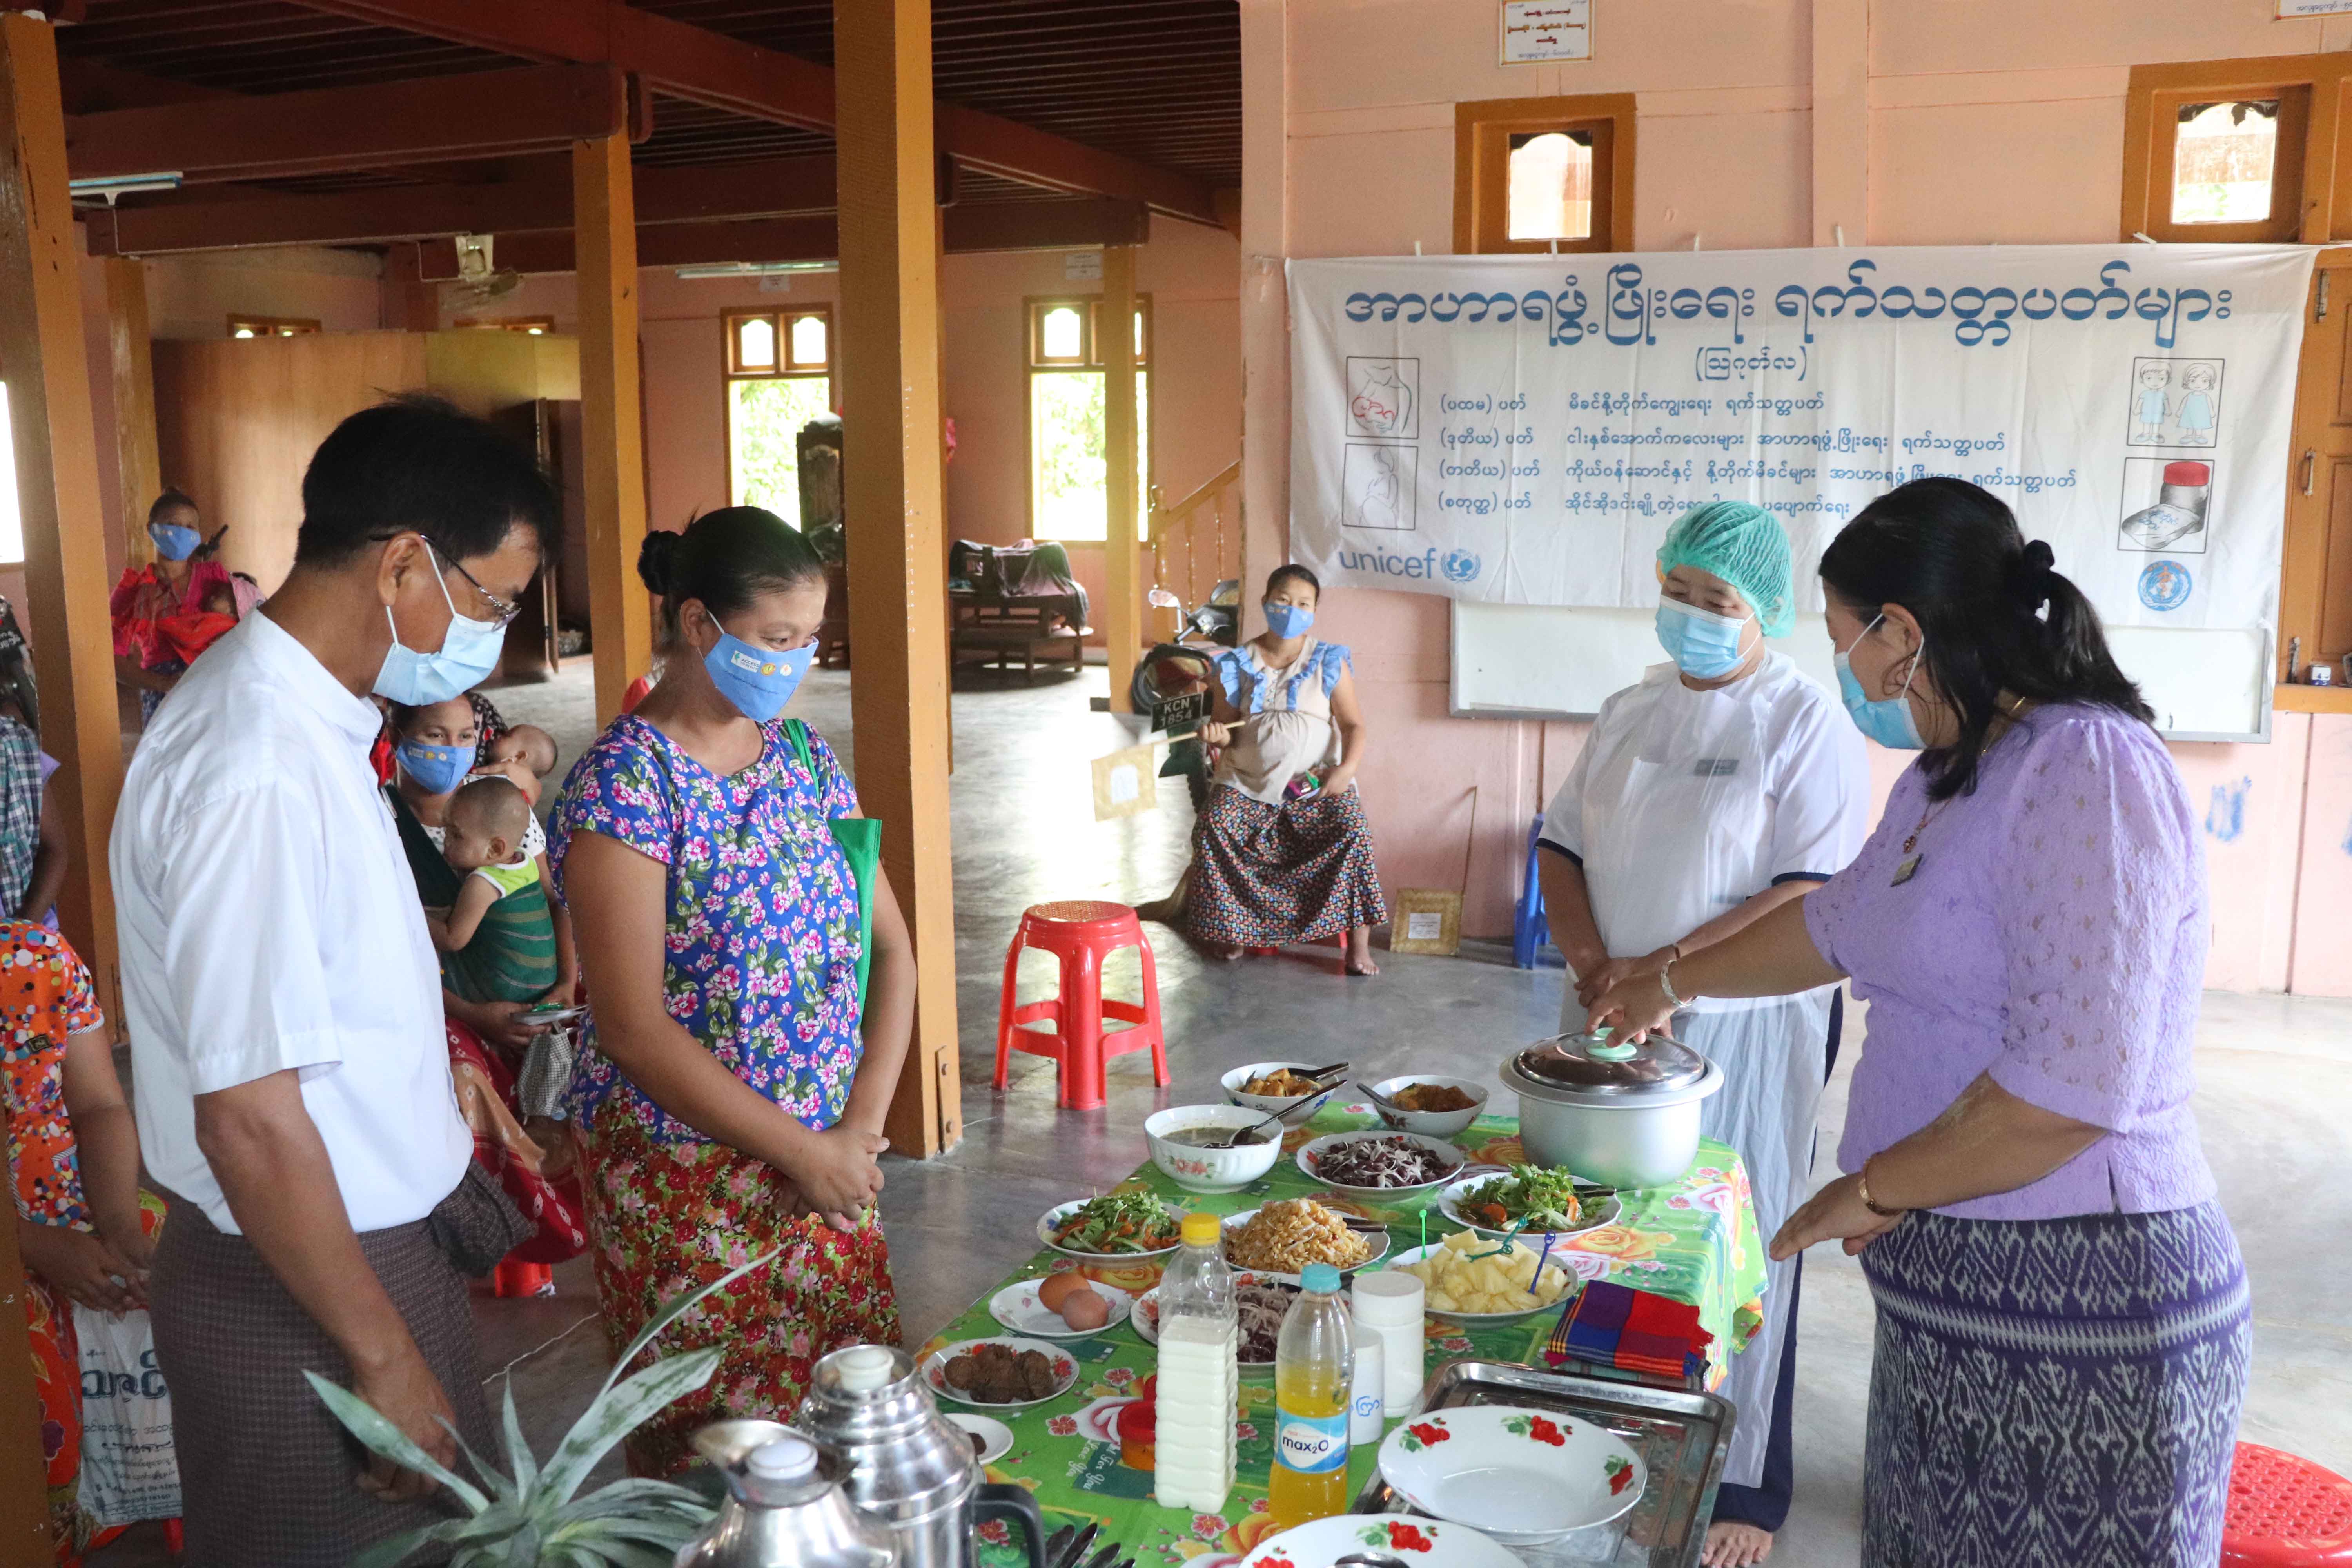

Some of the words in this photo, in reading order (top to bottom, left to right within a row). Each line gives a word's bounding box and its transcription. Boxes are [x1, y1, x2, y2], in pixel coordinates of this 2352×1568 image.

[1775, 259, 2232, 349] ရက်သတ္တပတ်များ
[1499, 392, 1526, 410] ပတ်
[1726, 392, 1824, 416] ရက်သတ္တပတ်
[1506, 427, 1533, 444] ပတ်
[1902, 430, 2005, 456] ရက်သတ္တပတ်
[1512, 459, 1540, 476] ပတ်
[1504, 492, 1531, 509] ပတ်
[1339, 546, 1437, 579] unicef
[1164, 697, 1190, 715] KCN
[1161, 710, 1192, 727] 1854
